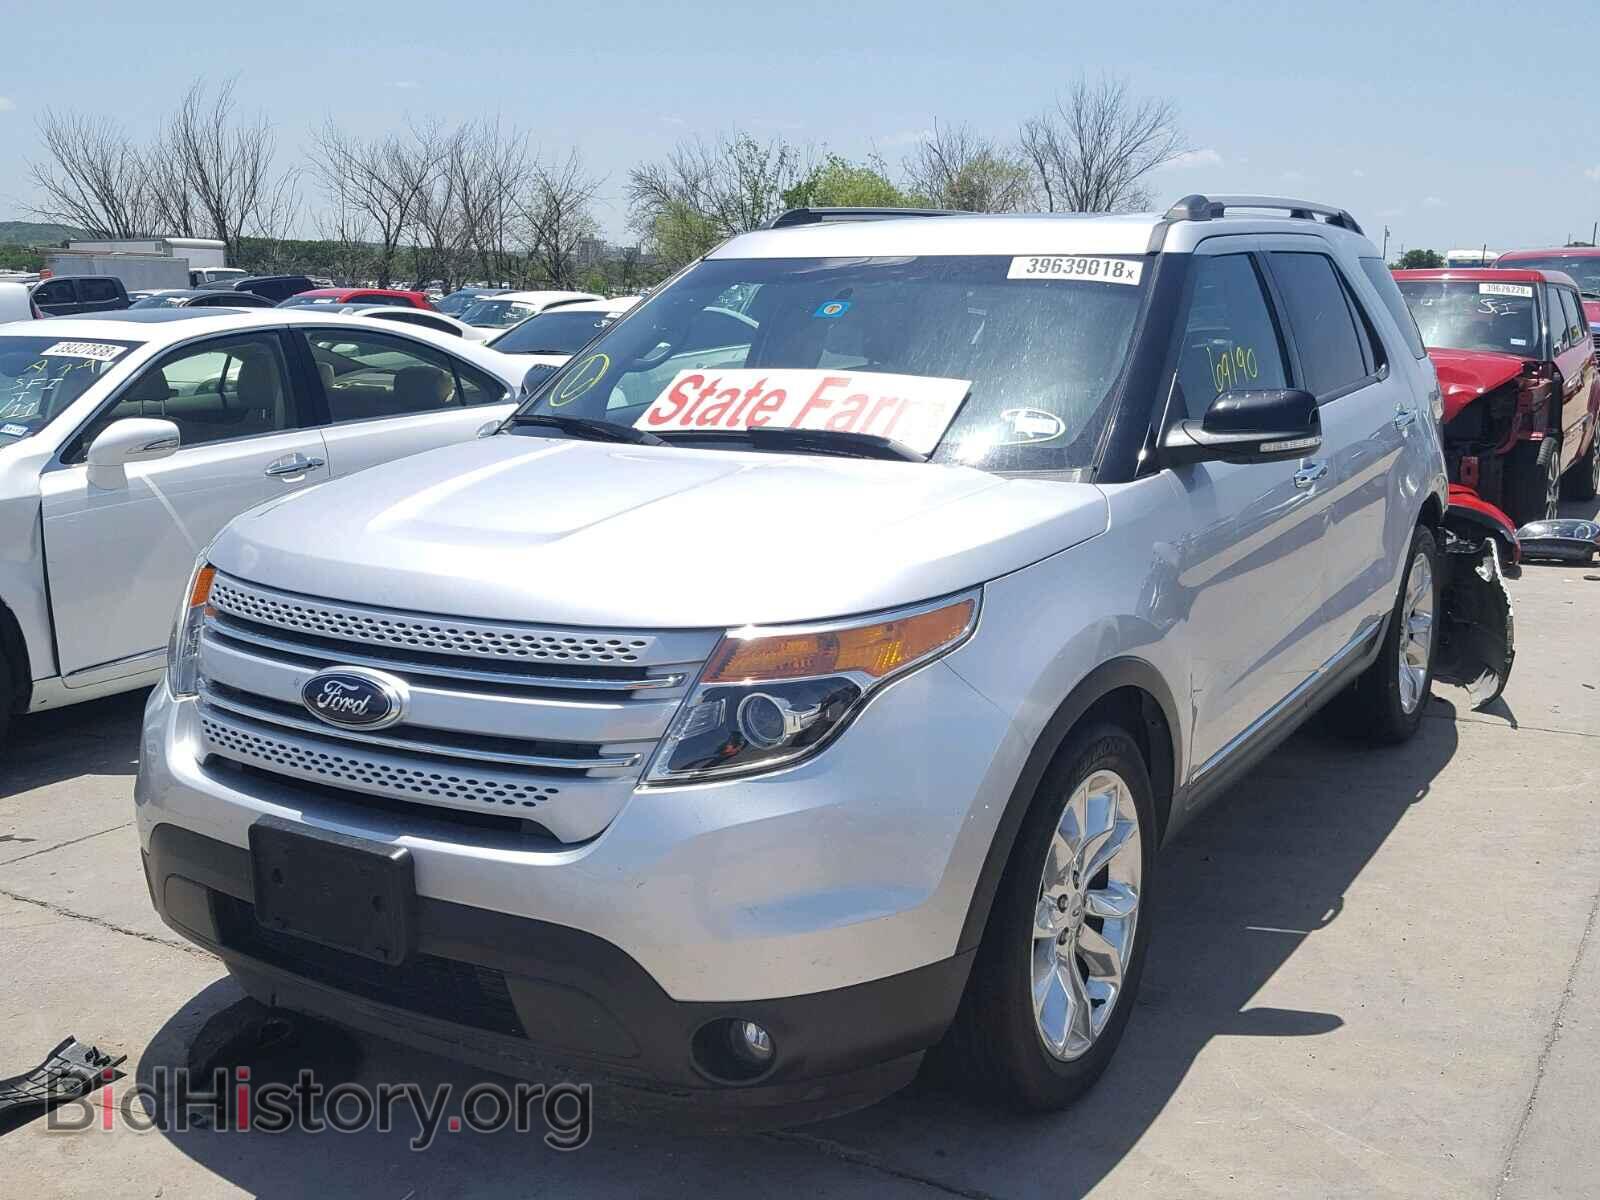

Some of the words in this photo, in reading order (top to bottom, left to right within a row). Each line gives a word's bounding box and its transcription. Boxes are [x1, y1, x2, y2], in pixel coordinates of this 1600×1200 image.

[1026, 257, 1135, 279] 39639018x
[647, 374, 788, 428] State
[790, 377, 932, 440] Far
[317, 680, 371, 715] Ford
